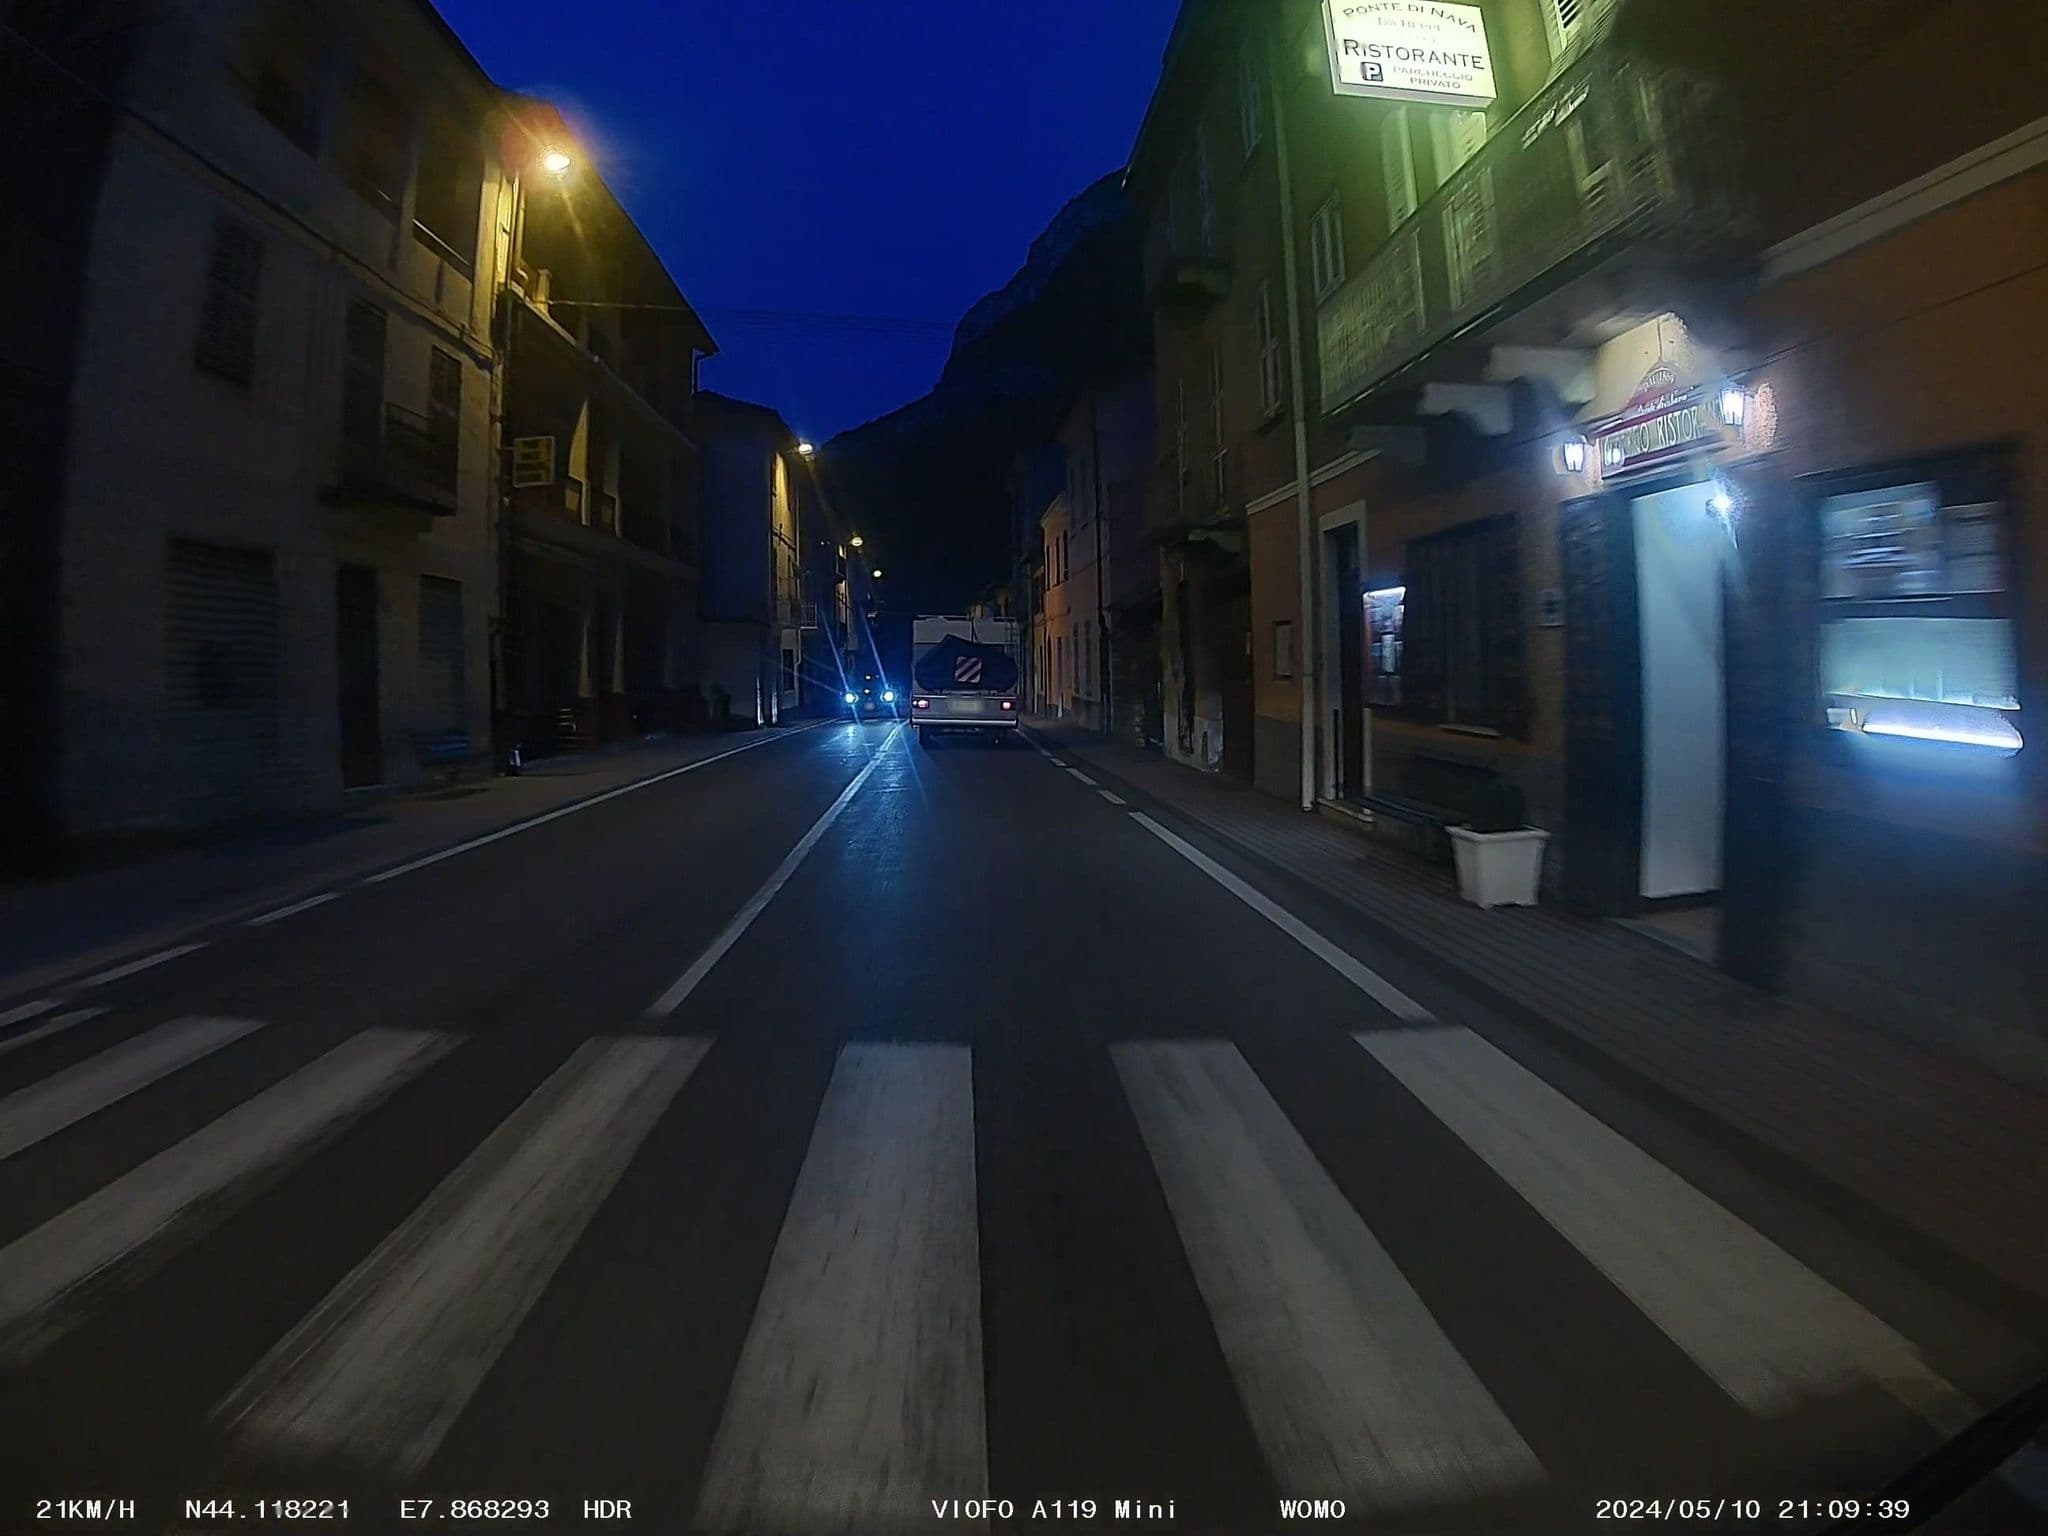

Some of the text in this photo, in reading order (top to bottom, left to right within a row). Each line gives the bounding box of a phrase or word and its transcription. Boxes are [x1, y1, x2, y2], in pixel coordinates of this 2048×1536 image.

[1342, 2, 1401, 17] PONTE
[1407, 4, 1424, 13] DI
[1431, 7, 1476, 33] NAVA
[1343, 38, 1485, 70] RISTORANTE
[1410, 77, 1462, 89] PRIVATO
